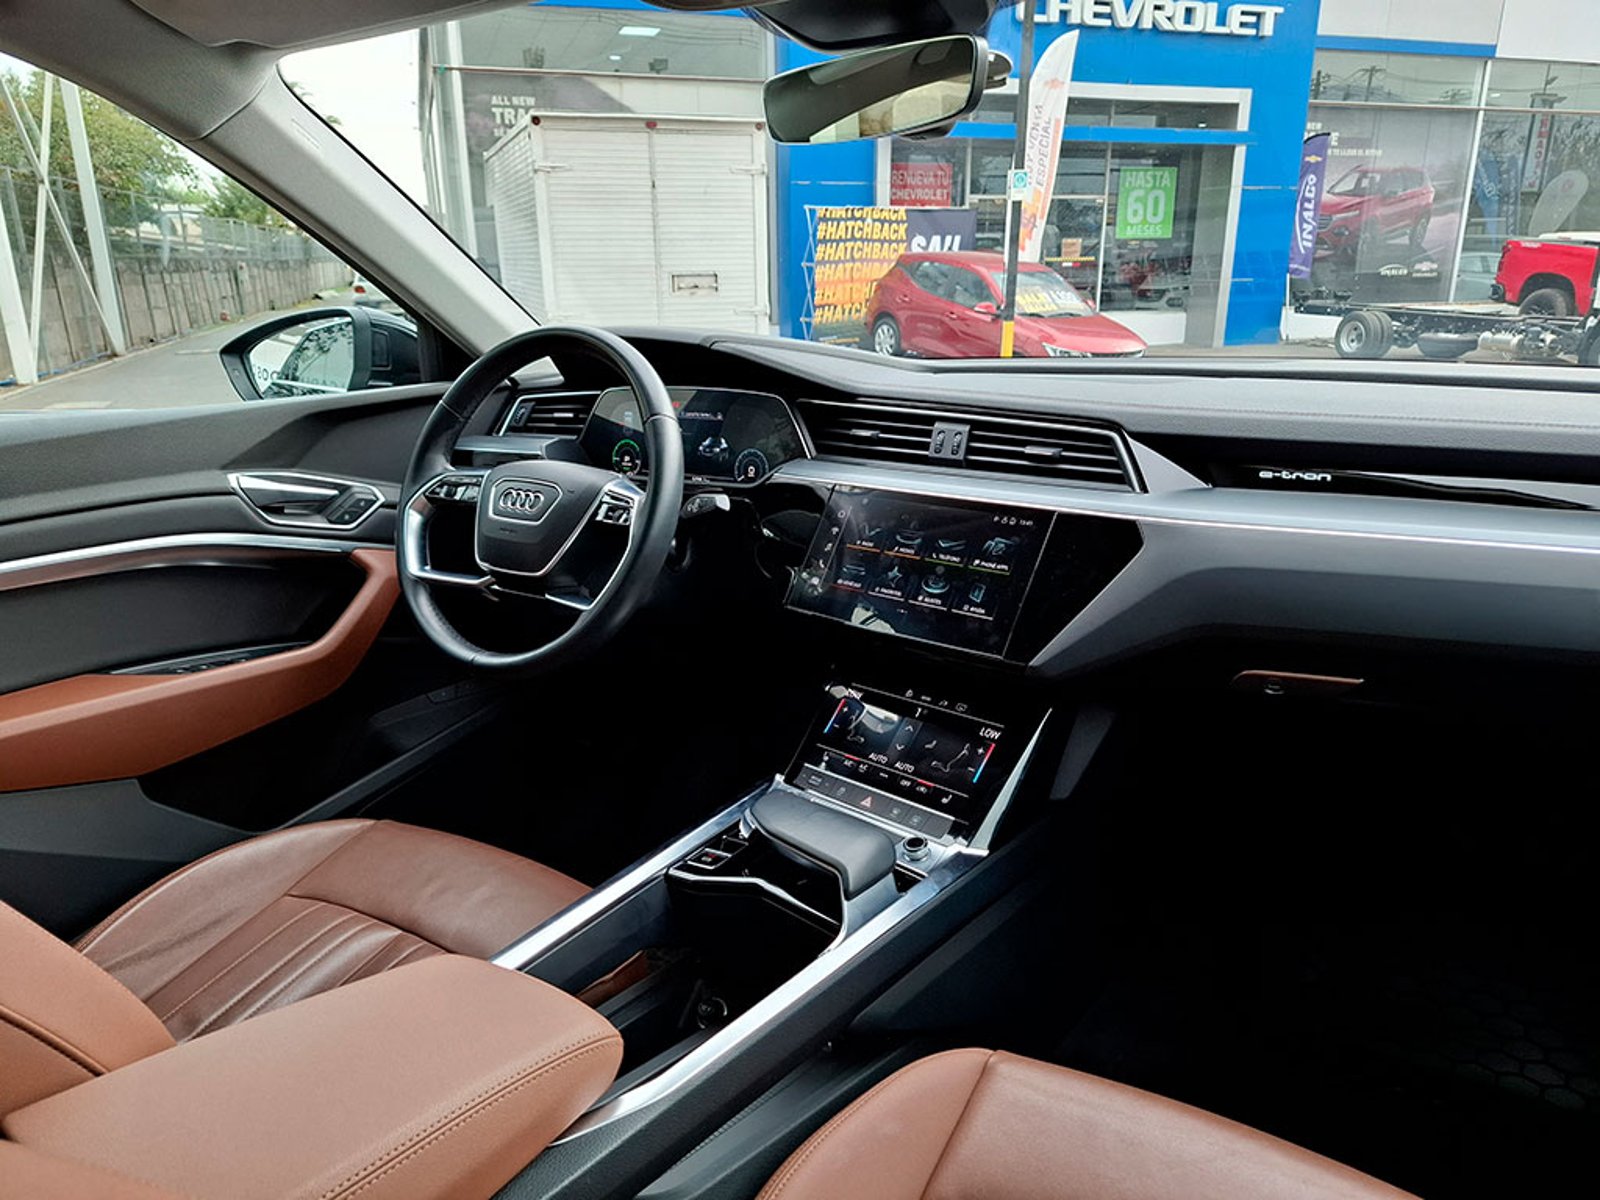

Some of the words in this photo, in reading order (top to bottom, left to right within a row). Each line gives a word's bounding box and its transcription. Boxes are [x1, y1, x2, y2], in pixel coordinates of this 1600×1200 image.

[1015, 0, 1284, 36] CHEVROLET
[491, 95, 510, 106] ALL
[512, 95, 536, 106] NEW
[1125, 171, 1171, 188] HASTA
[891, 188, 950, 200] CHEVROLET
[1126, 189, 1165, 225] 60
[816, 220, 908, 241] #HATCHBACK
[1125, 224, 1163, 236] MESES
[815, 241, 908, 261] #HATCHBACK
[1258, 470, 1332, 482] e-tron
[979, 726, 1001, 740] LOW
[868, 752, 888, 764] AUTO
[894, 761, 915, 773] AUTO
